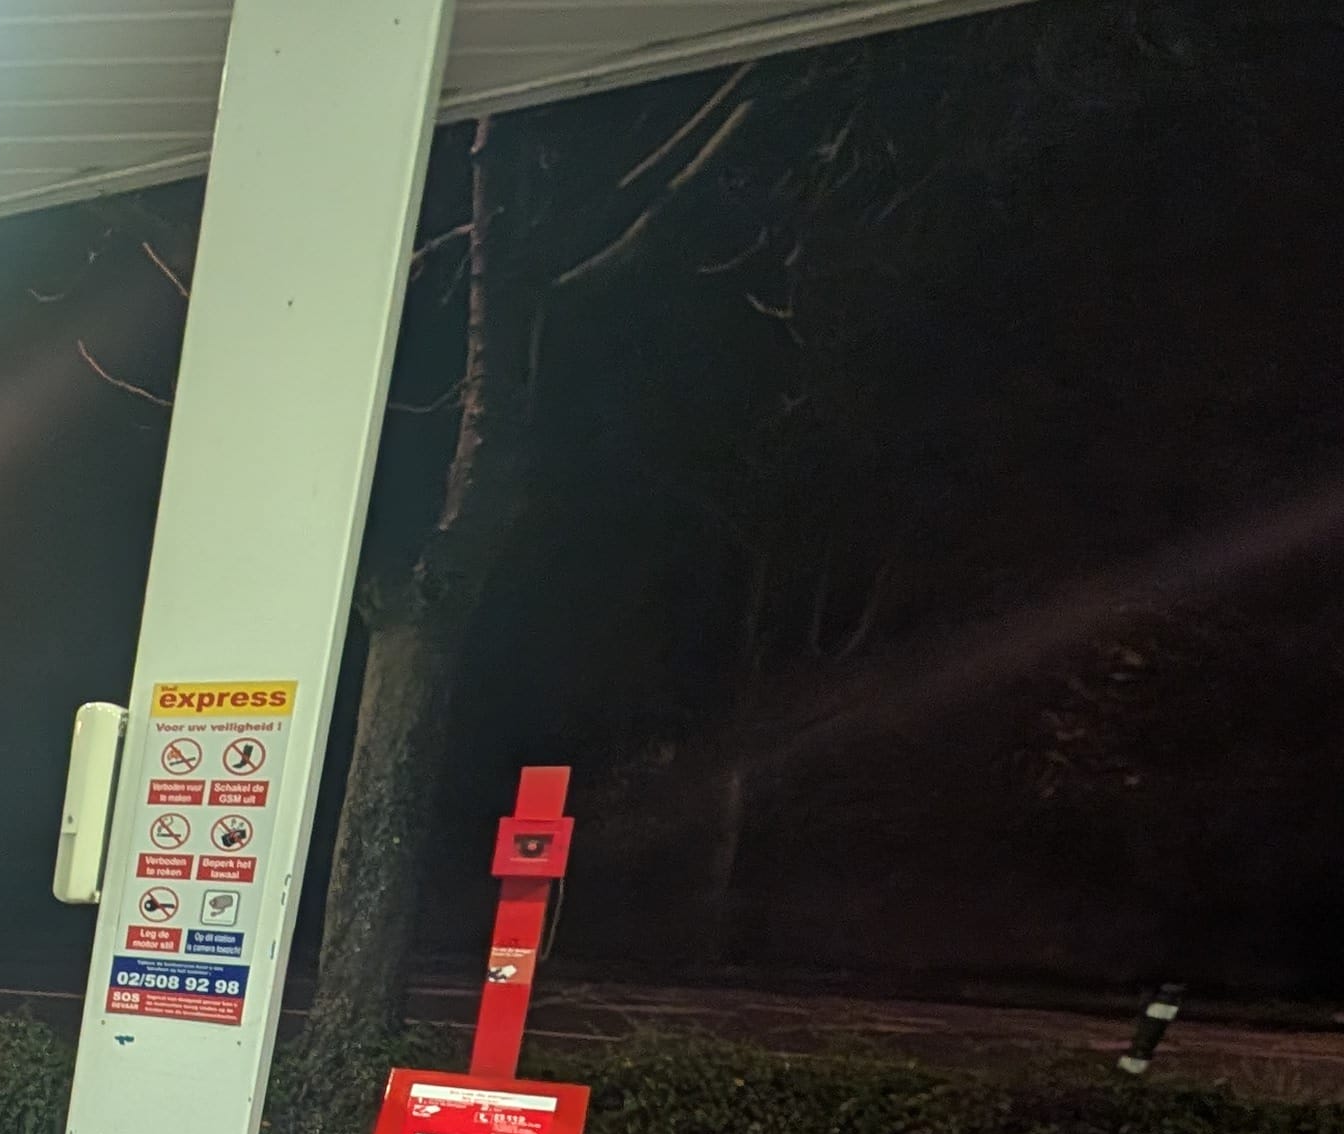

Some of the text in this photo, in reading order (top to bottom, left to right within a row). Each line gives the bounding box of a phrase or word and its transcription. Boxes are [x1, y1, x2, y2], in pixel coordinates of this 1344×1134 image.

[159, 690, 287, 713] express
[156, 722, 185, 732] Voor
[188, 724, 207, 732] uw
[211, 722, 273, 733] veiligheid
[214, 782, 264, 793] Schakel de
[219, 795, 257, 804] GSM uit
[145, 856, 187, 866] Verboden
[202, 858, 252, 869] Beperk het
[146, 867, 182, 877] te roken
[140, 928, 170, 939] Leg de
[194, 931, 204, 943] Op
[116, 971, 179, 990] 02/508
[185, 977, 209, 992] 92
[215, 979, 240, 995] 98
[113, 991, 141, 1003] SOS
